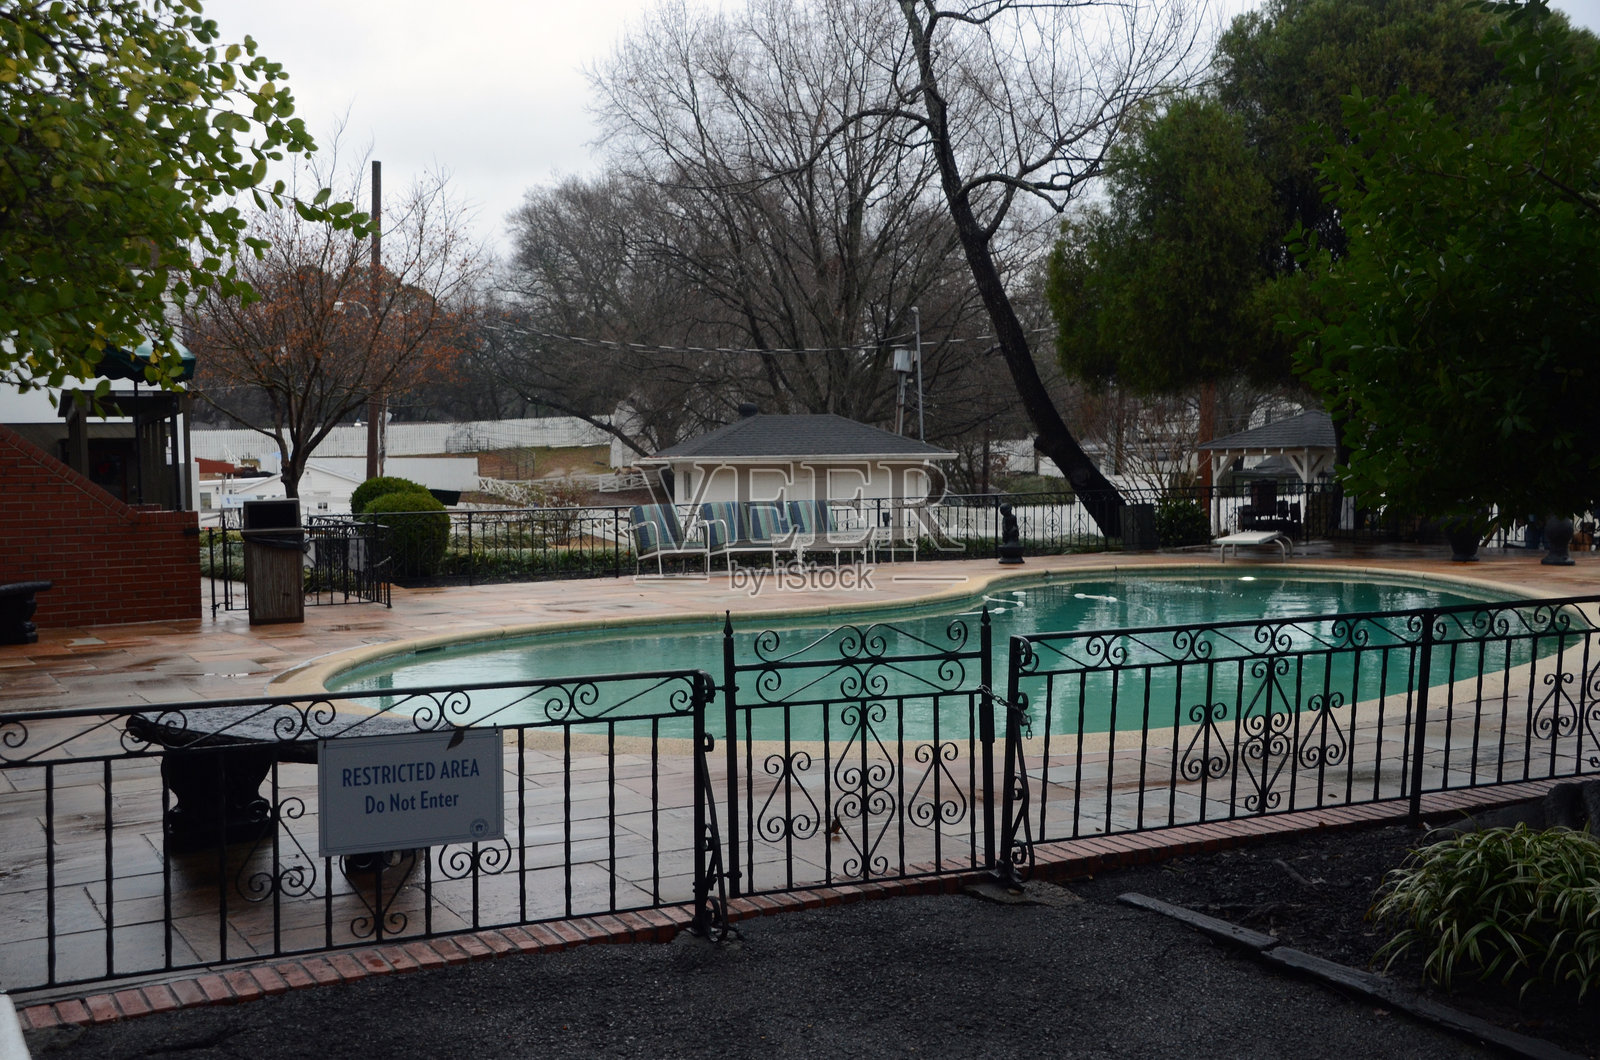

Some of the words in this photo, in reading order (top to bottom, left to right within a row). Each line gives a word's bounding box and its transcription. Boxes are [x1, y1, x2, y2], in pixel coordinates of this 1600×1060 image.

[342, 762, 436, 787] RESTRICTED
[440, 758, 480, 779] AREA
[365, 795, 385, 814] Do
[389, 793, 416, 812] Not
[420, 790, 459, 809] Enter
